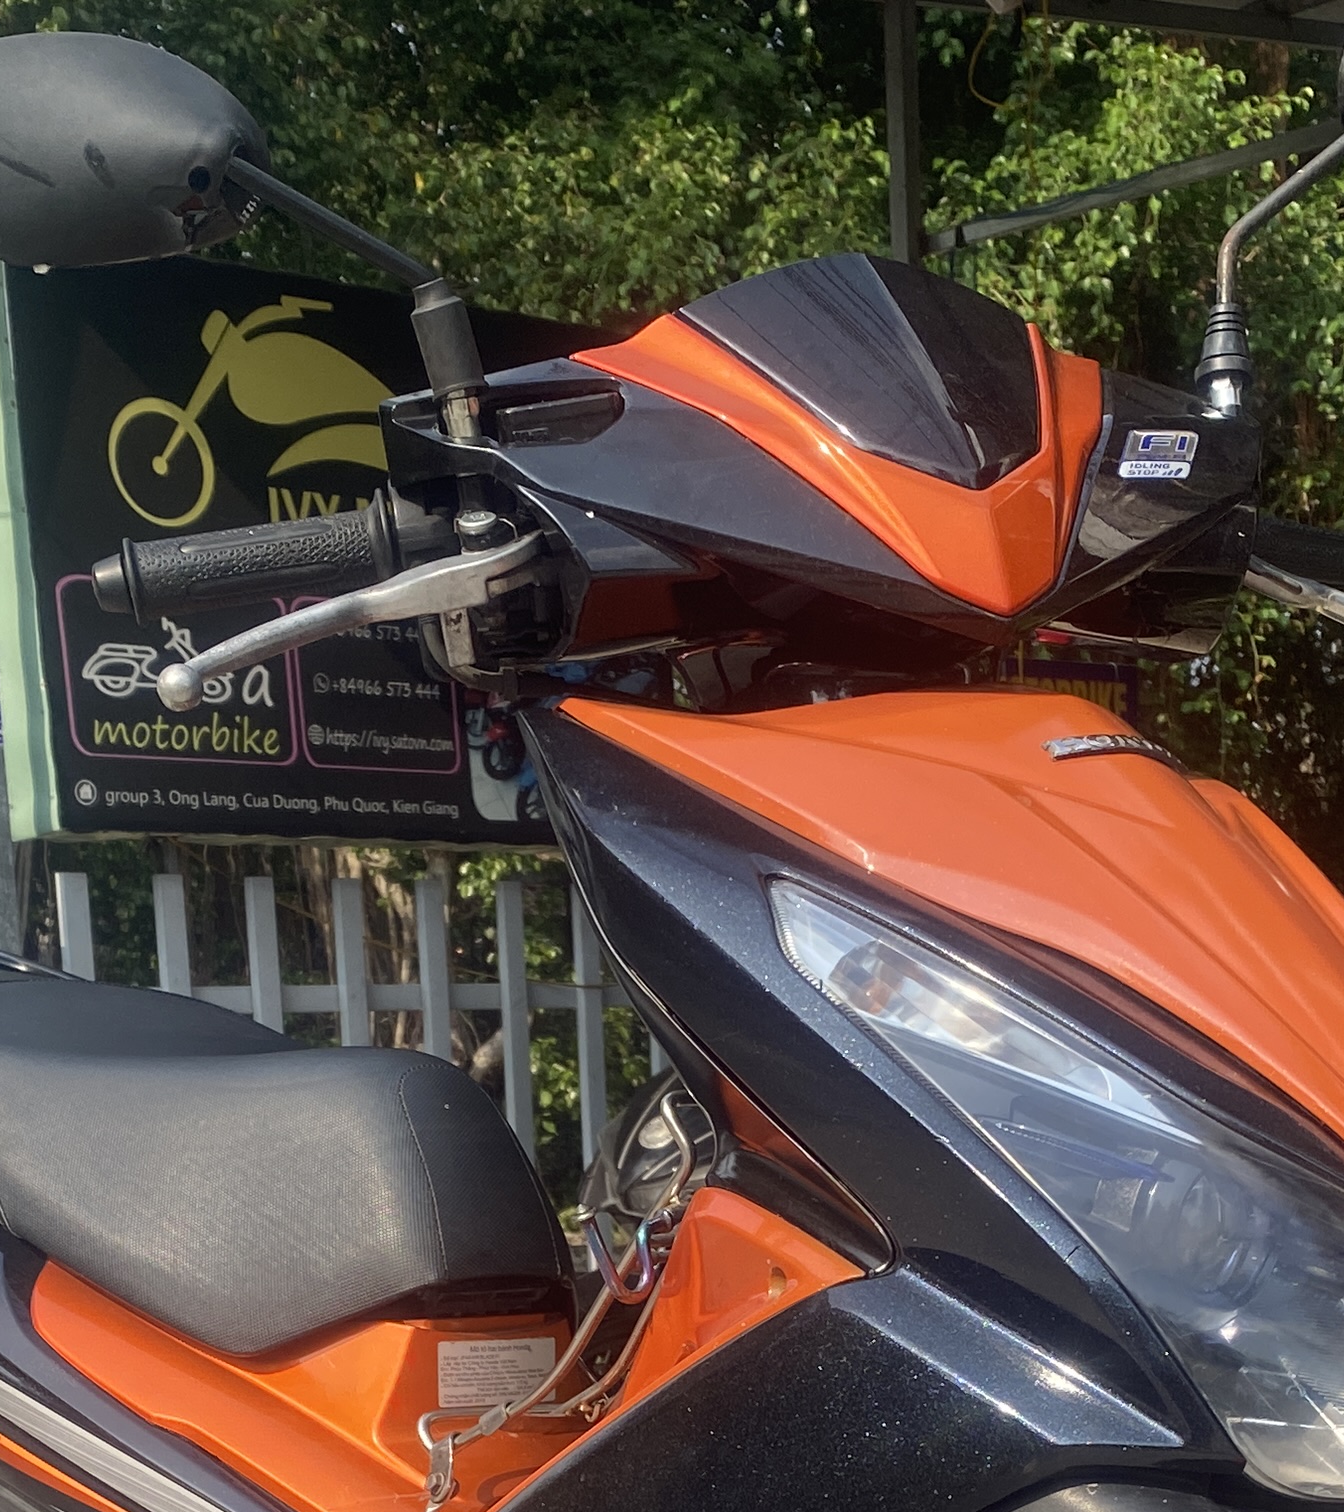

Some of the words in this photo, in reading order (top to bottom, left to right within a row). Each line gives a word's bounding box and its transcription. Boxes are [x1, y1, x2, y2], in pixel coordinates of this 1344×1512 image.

[1138, 434, 1189, 452] FI
[93, 711, 280, 755] motorbike
[106, 789, 149, 808] group
[152, 789, 165, 807] 3,
[168, 790, 200, 810] Ong
[203, 791, 240, 811] Lang,
[243, 793, 270, 809] Cua
[273, 794, 321, 814] Duong,
[323, 796, 349, 812] Phu
[352, 797, 390, 814] Quoc,
[393, 799, 420, 814] Kien
[422, 800, 459, 819] Giang
